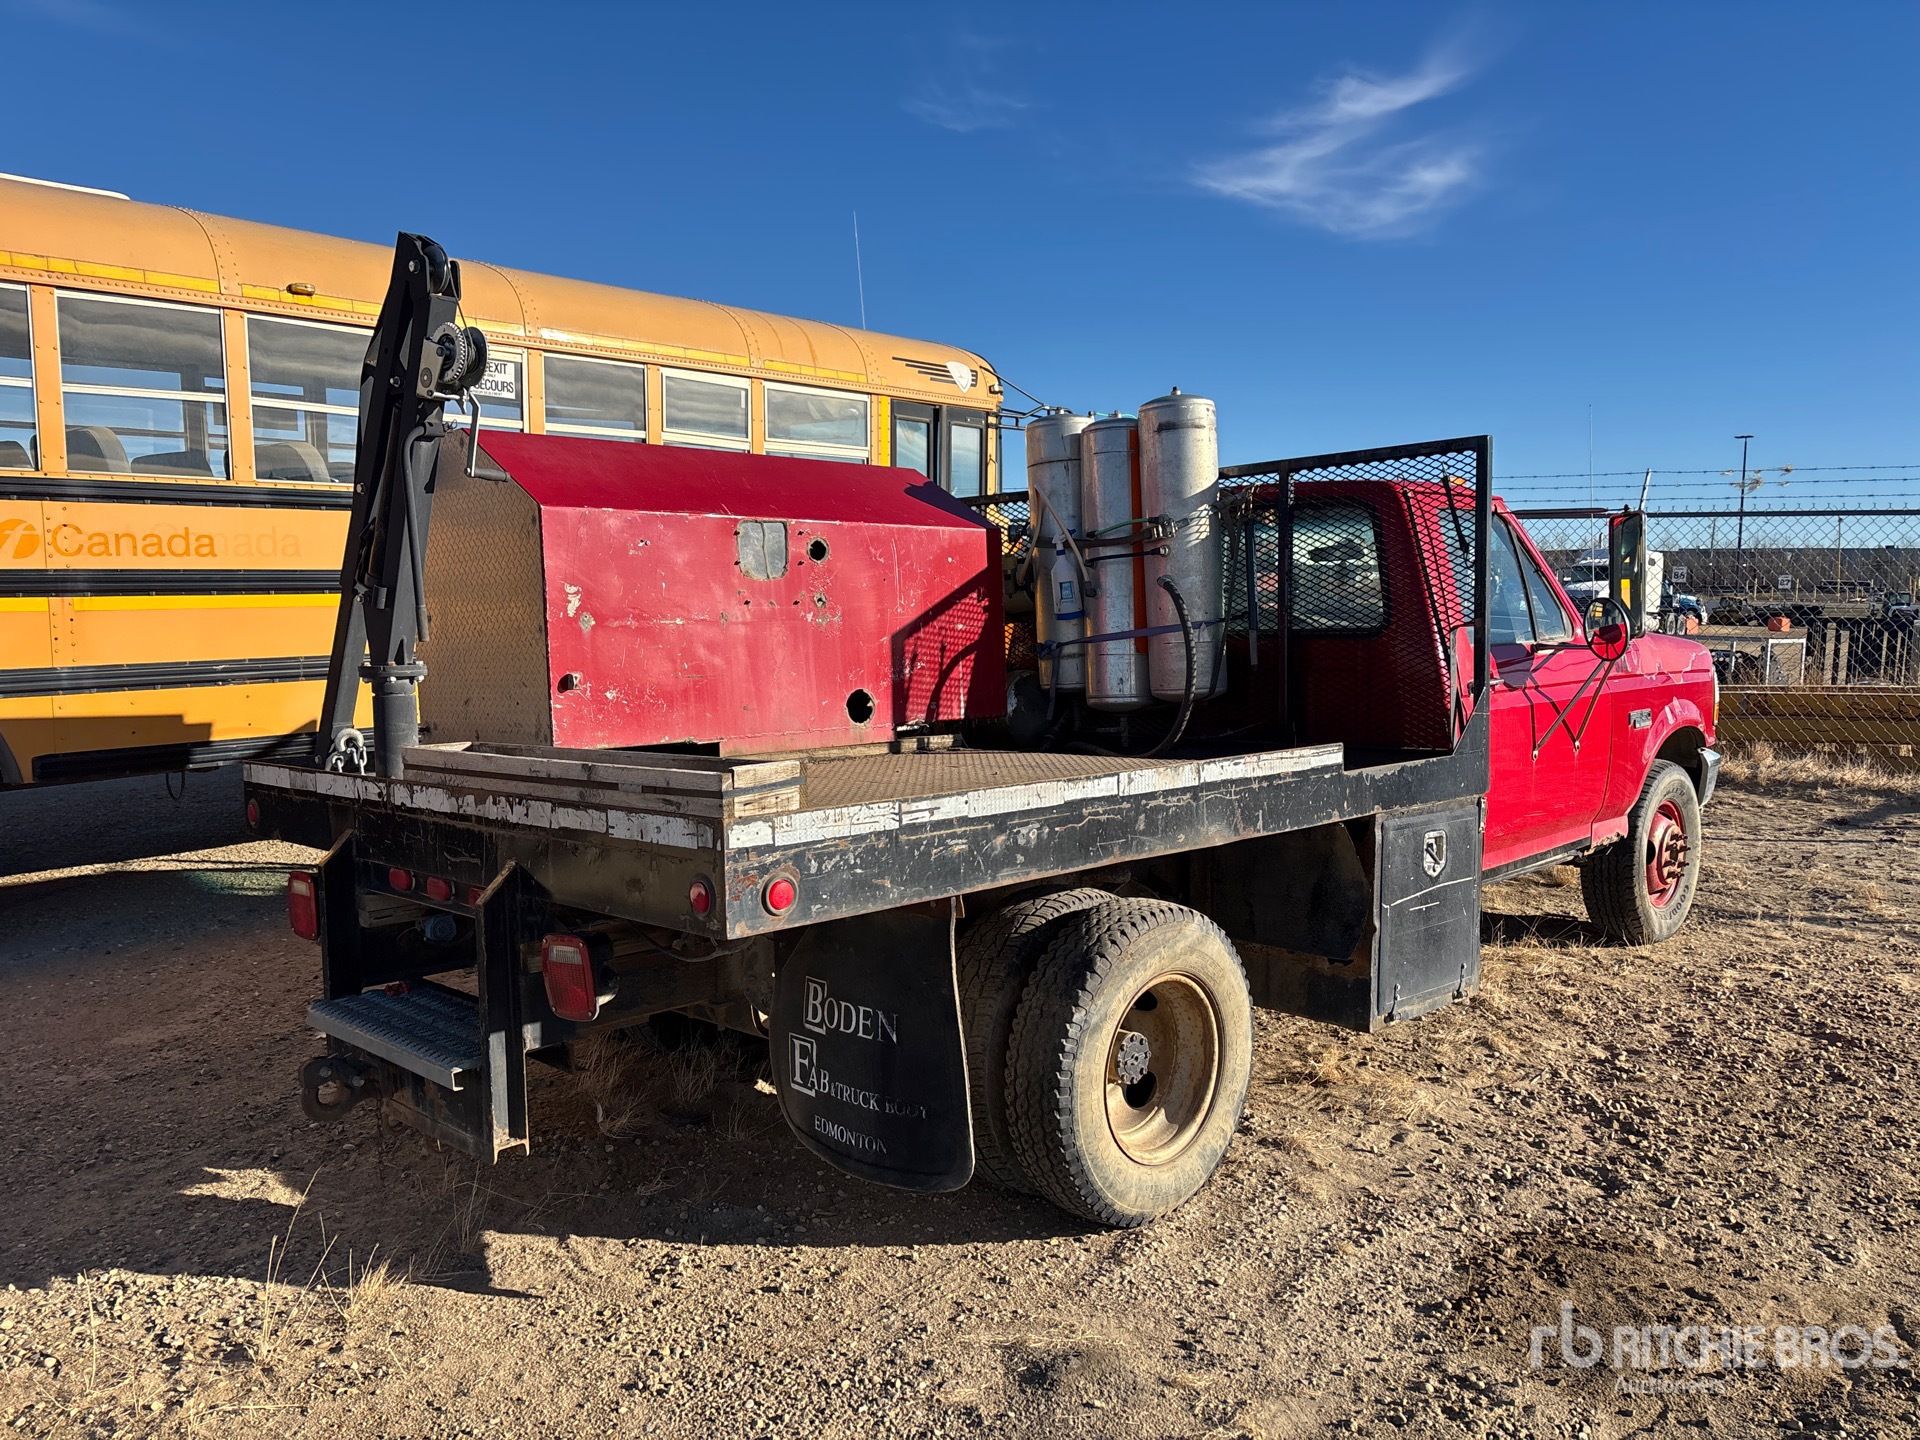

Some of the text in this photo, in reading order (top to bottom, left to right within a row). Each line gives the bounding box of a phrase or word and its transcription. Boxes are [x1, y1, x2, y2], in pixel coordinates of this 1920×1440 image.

[488, 362, 507, 374] EXIT
[50, 523, 218, 558] Canada
[1673, 571, 1685, 580] 86
[805, 980, 899, 1046] BODEN
[790, 1038, 830, 1095] FAB
[834, 1082, 880, 1112] TRUCK
[813, 1114, 888, 1155] EDMONTON
